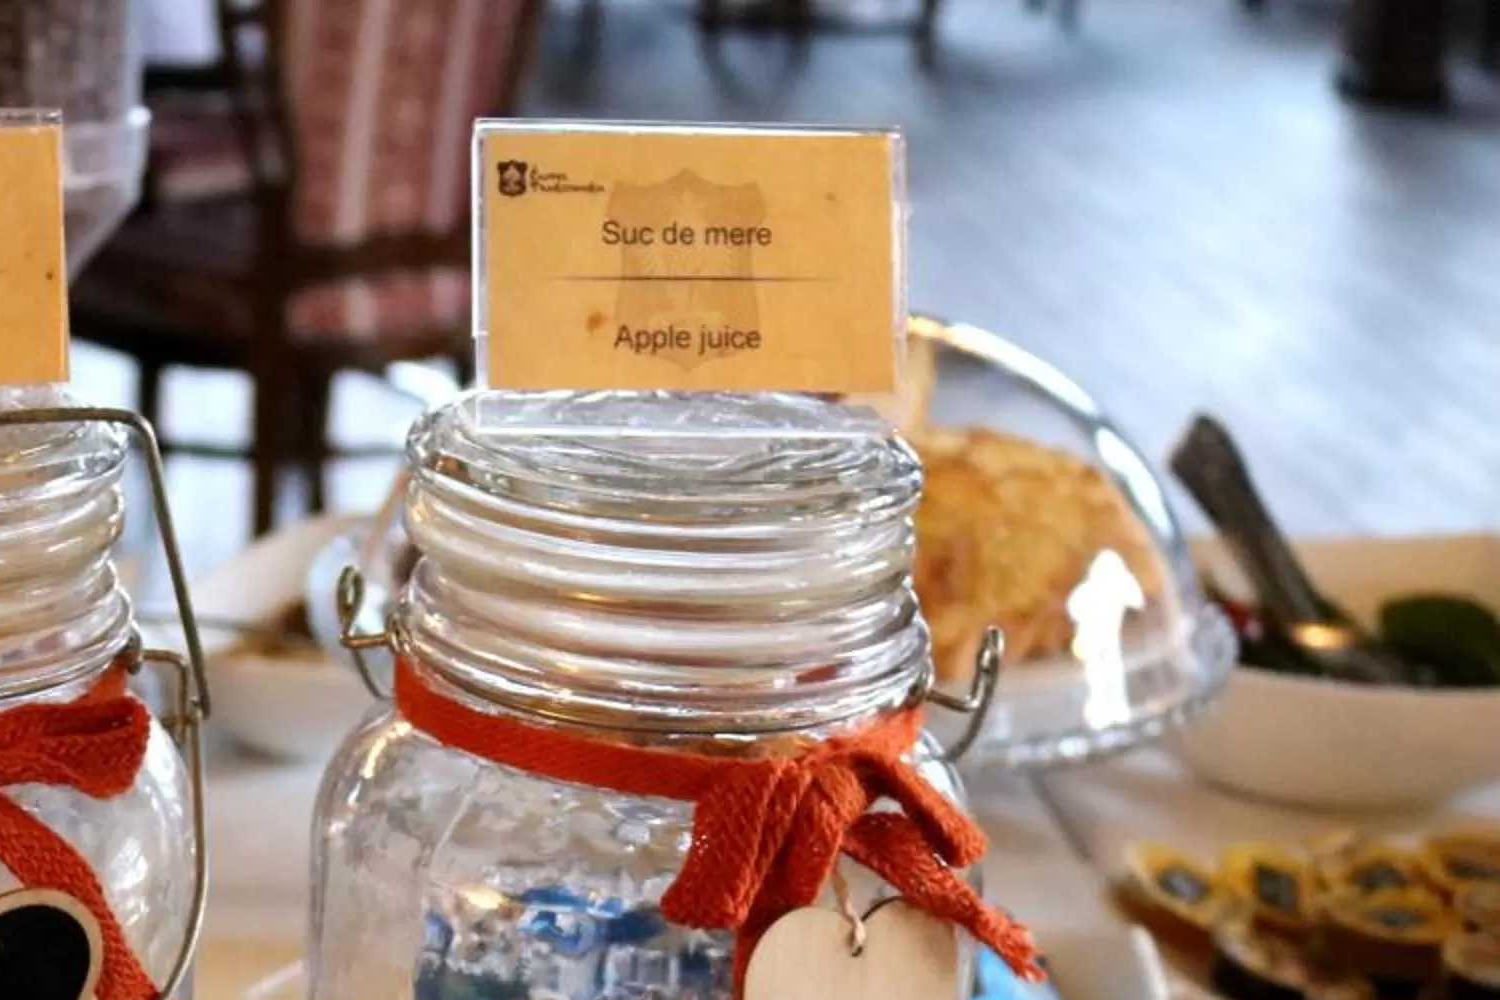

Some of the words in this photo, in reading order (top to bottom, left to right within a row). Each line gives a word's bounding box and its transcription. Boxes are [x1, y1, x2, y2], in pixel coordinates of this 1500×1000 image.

[601, 219, 655, 246] Suc
[662, 220, 696, 246] de
[704, 225, 773, 247] mere
[612, 323, 692, 355] Apple
[697, 323, 762, 357] juice
